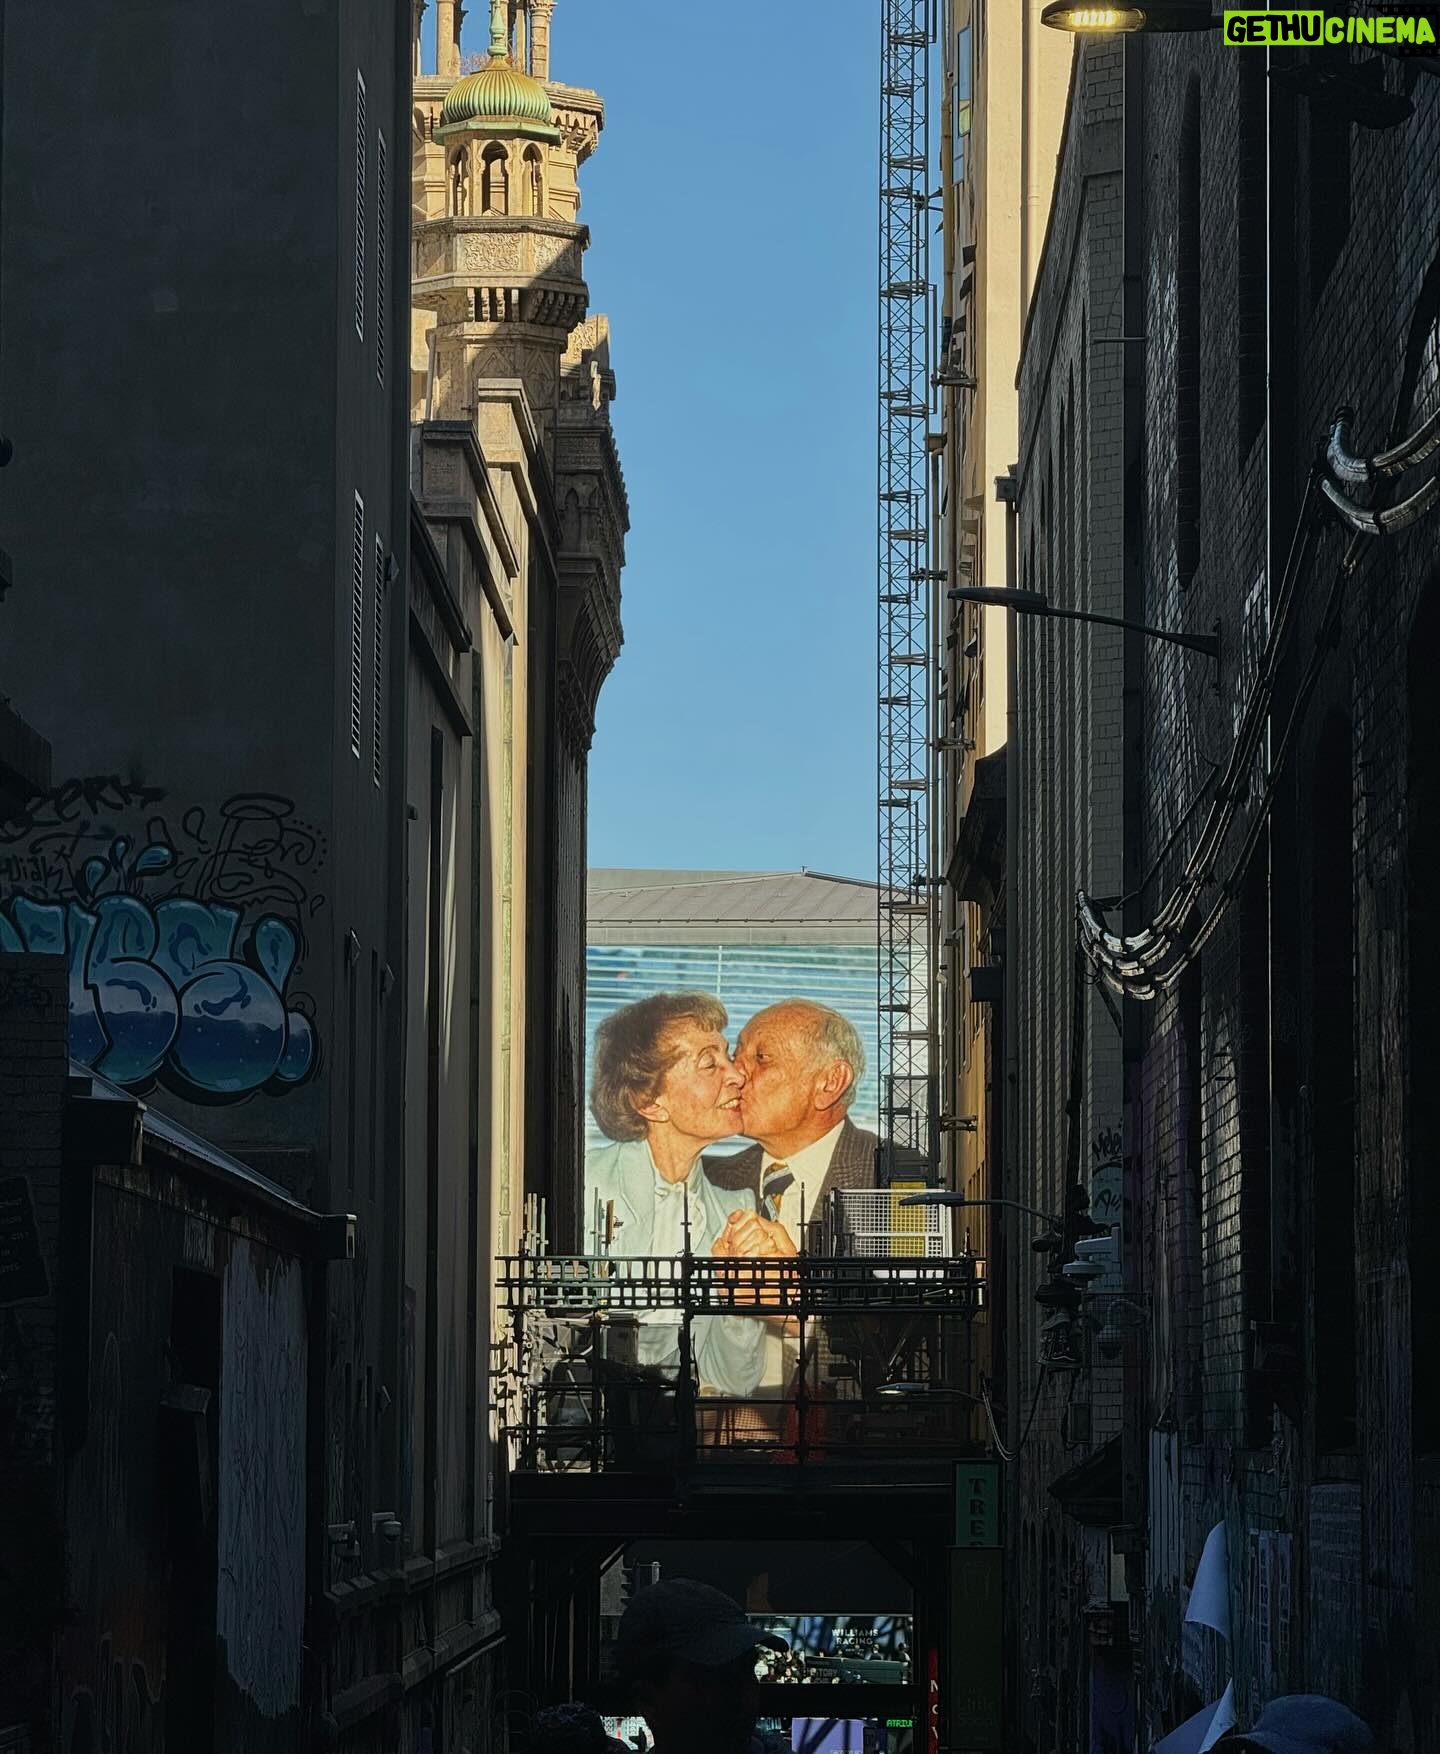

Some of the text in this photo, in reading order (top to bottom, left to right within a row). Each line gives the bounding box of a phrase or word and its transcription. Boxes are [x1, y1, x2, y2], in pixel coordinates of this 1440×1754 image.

[968, 1478, 985, 1545] TRE
[831, 1628, 879, 1637] WILLIAMS
[837, 1637, 873, 1645] RACING
